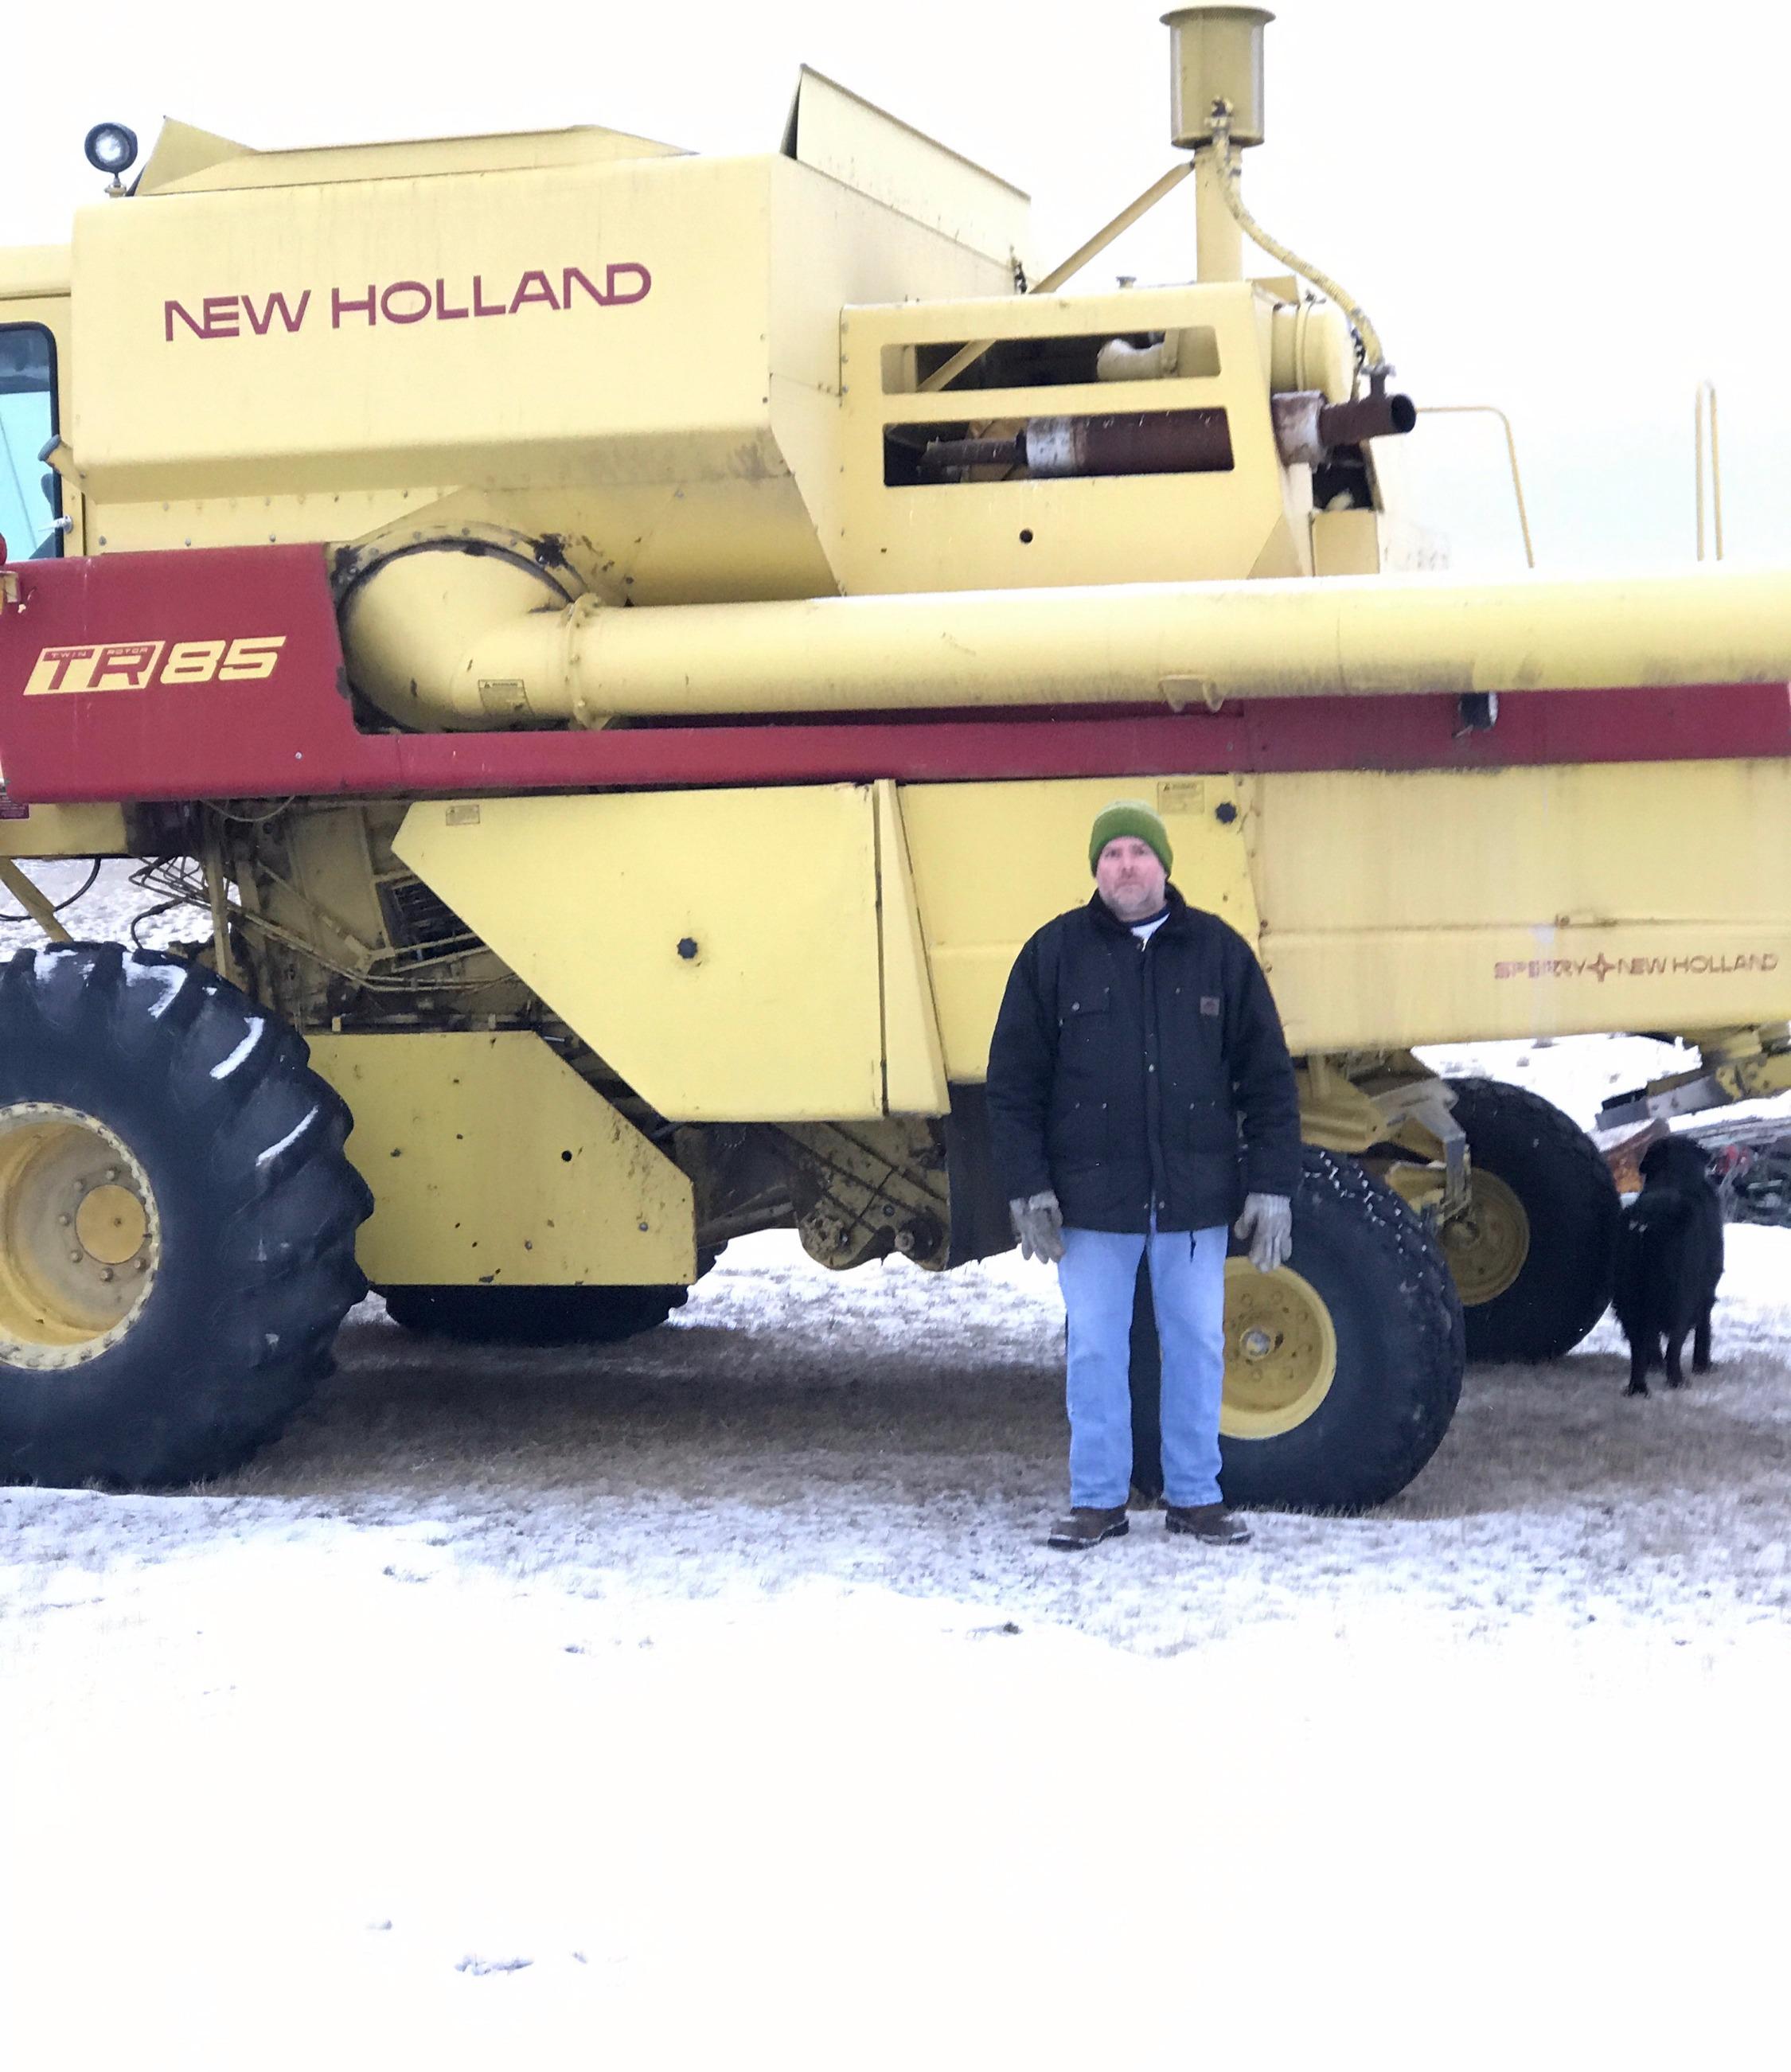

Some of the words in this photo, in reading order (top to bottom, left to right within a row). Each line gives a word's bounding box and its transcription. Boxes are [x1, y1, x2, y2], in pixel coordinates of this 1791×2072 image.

[164, 289, 311, 341] NEW
[331, 262, 653, 330] HOLLAND
[107, 646, 149, 655] ROTOR
[1617, 957, 1668, 976] NEW
[1672, 953, 1780, 974] HOLLAND
